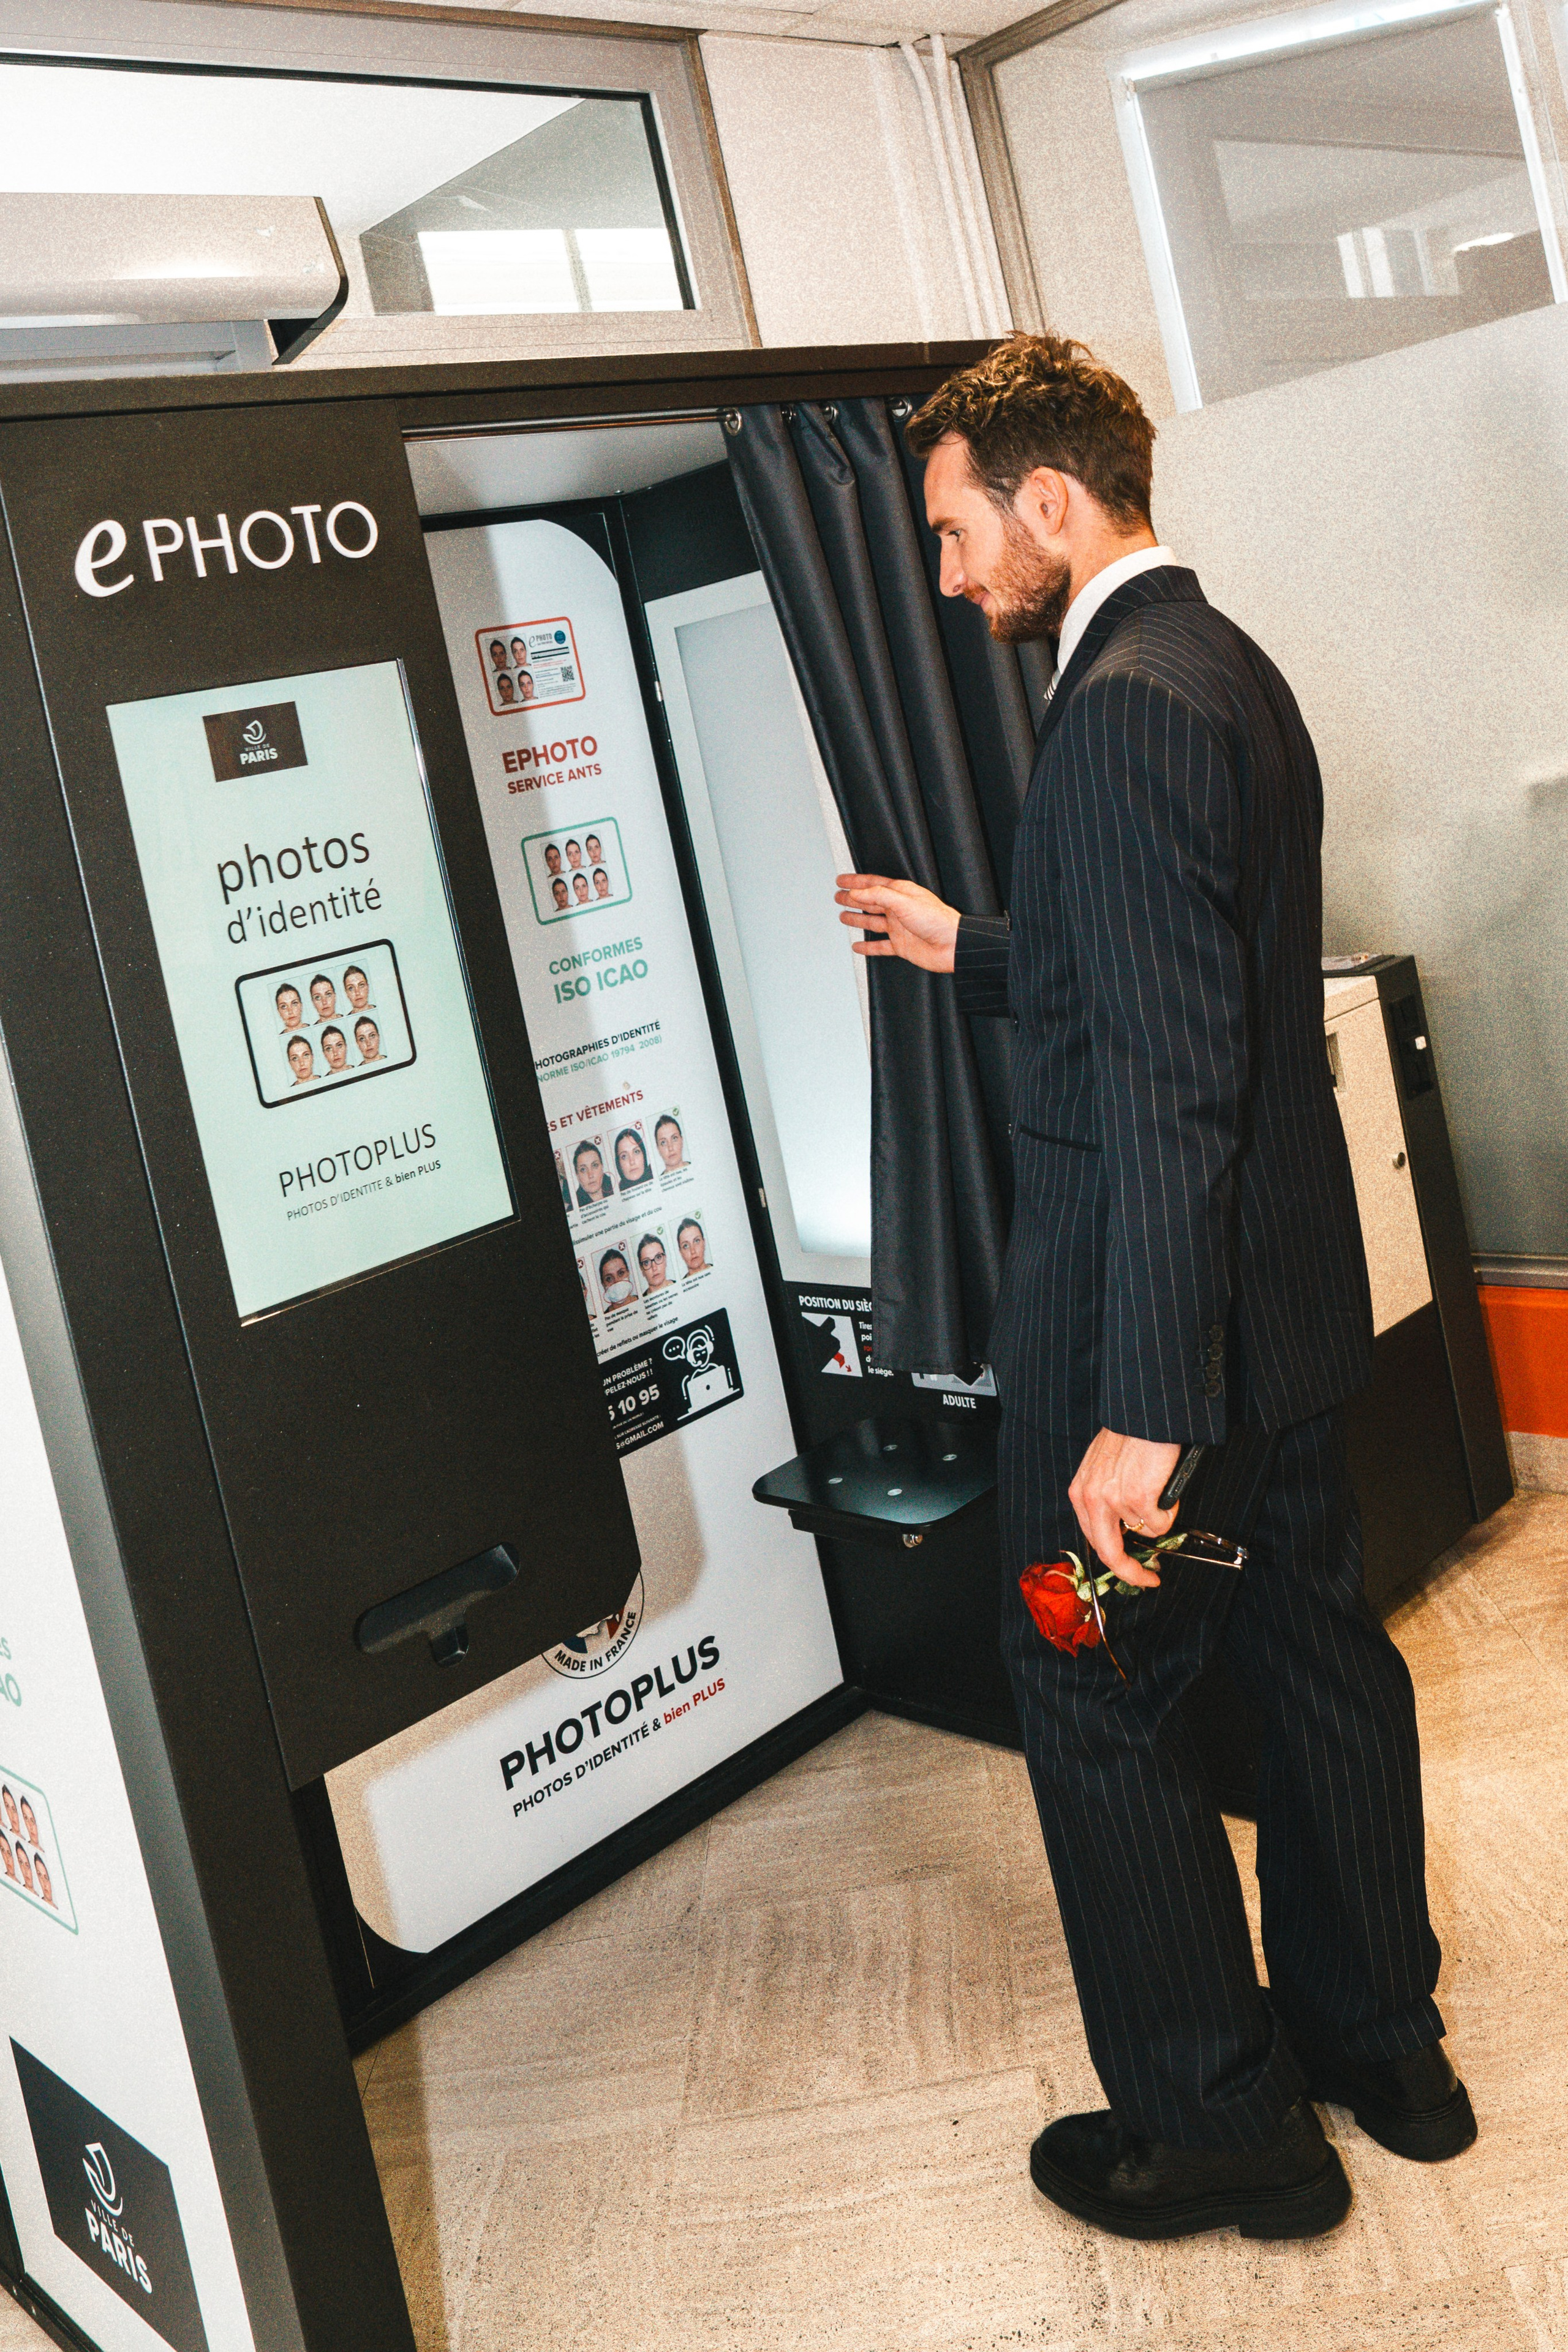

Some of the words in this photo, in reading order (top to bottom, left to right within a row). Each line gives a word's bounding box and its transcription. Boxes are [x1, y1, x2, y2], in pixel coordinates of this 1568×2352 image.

[239, 748, 278, 764] PARIS
[502, 736, 597, 774] EPHOTO
[507, 771, 563, 794] SERVICE
[568, 763, 602, 782] ANTS
[217, 832, 370, 905] photos
[227, 878, 382, 944] d'identité
[549, 937, 643, 975] CONFORMES
[554, 976, 591, 1004] ISO
[596, 959, 648, 991] ICAO
[534, 1038, 609, 1070] HOTOGRAPHIES
[611, 1019, 661, 1044] D'IDENTITÉ
[571, 1053, 609, 1072] ISO/ICAO
[611, 1044, 635, 1058] 19794
[560, 1114, 573, 1128] ET
[576, 1090, 644, 1121] VÊTEMENTS
[279, 1123, 437, 1198] PHOTOPLUS
[287, 1199, 328, 1221] PHOTOS
[385, 1177, 393, 1187] &
[395, 1169, 417, 1184] bien
[418, 1159, 442, 1176] PLUS
[626, 1215, 641, 1224] visage
[798, 1295, 842, 1311] POSITION
[842, 1300, 855, 1311] DU
[617, 1338, 632, 1348] reflets
[664, 1317, 678, 1326] visage
[861, 1333, 872, 1342] poi
[605, 1371, 646, 1396] PELEZ-NOUS
[612, 1359, 649, 1382] PROBLÈME
[868, 1365, 874, 1374] le
[875, 1367, 894, 1377] siège.
[617, 1396, 636, 1415] 10
[639, 1384, 660, 1405] 95
[943, 1394, 976, 1409] ADULTE
[554, 1650, 586, 1672] MADE
[589, 1657, 603, 1671] IN
[605, 1611, 636, 1662] FRANCE
[499, 1635, 720, 1792] PHOTOPLUS
[512, 1772, 573, 1817] PHOTOS
[575, 1721, 650, 1780] D'IDENTITÉ
[652, 1718, 662, 1732] &
[663, 1702, 690, 1725] bien
[692, 1678, 725, 1706] PLUS
[91, 2199, 118, 2232] VILLE
[121, 2227, 135, 2247] DE
[85, 2207, 152, 2294] PARIS
